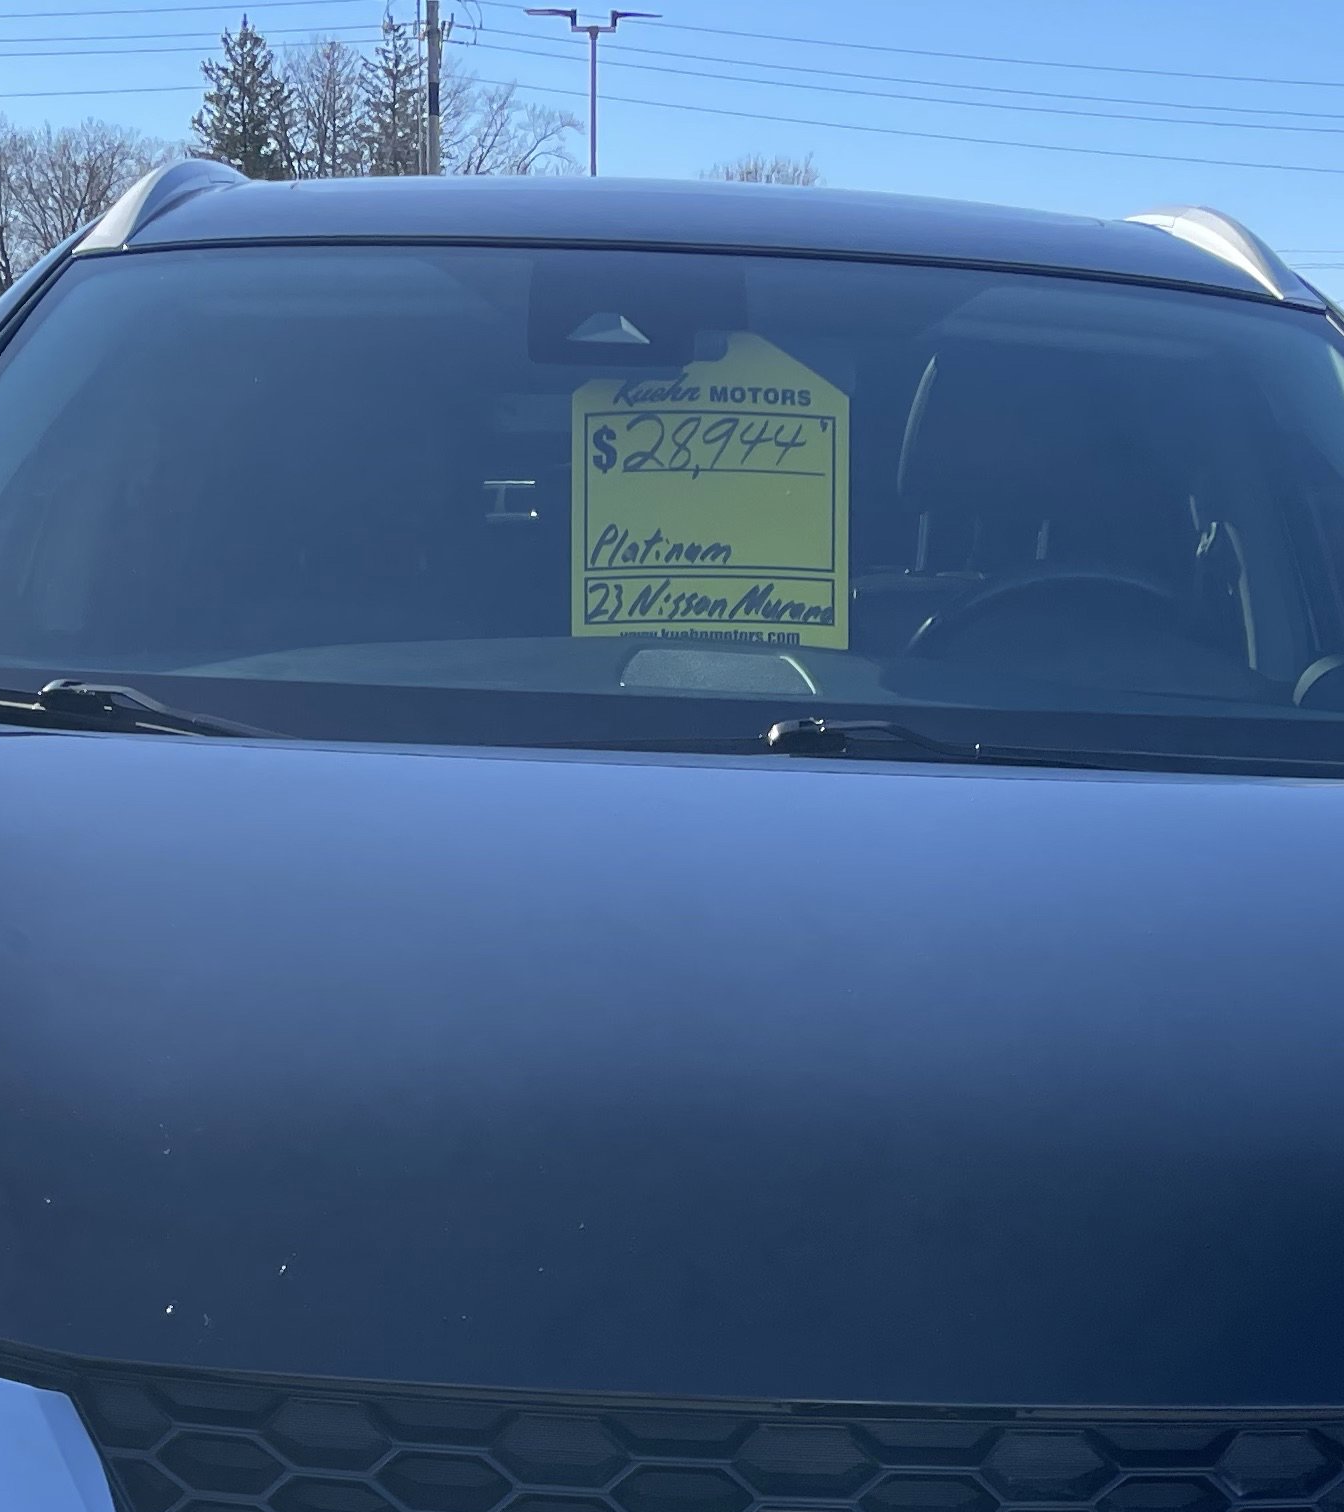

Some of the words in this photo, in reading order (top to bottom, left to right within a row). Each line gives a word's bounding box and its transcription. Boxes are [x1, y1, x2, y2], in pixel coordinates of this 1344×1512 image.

[613, 373, 701, 408] Kuehn
[709, 384, 812, 407] MOTORS
[590, 523, 732, 568] Platinum
[587, 582, 624, 622] 23
